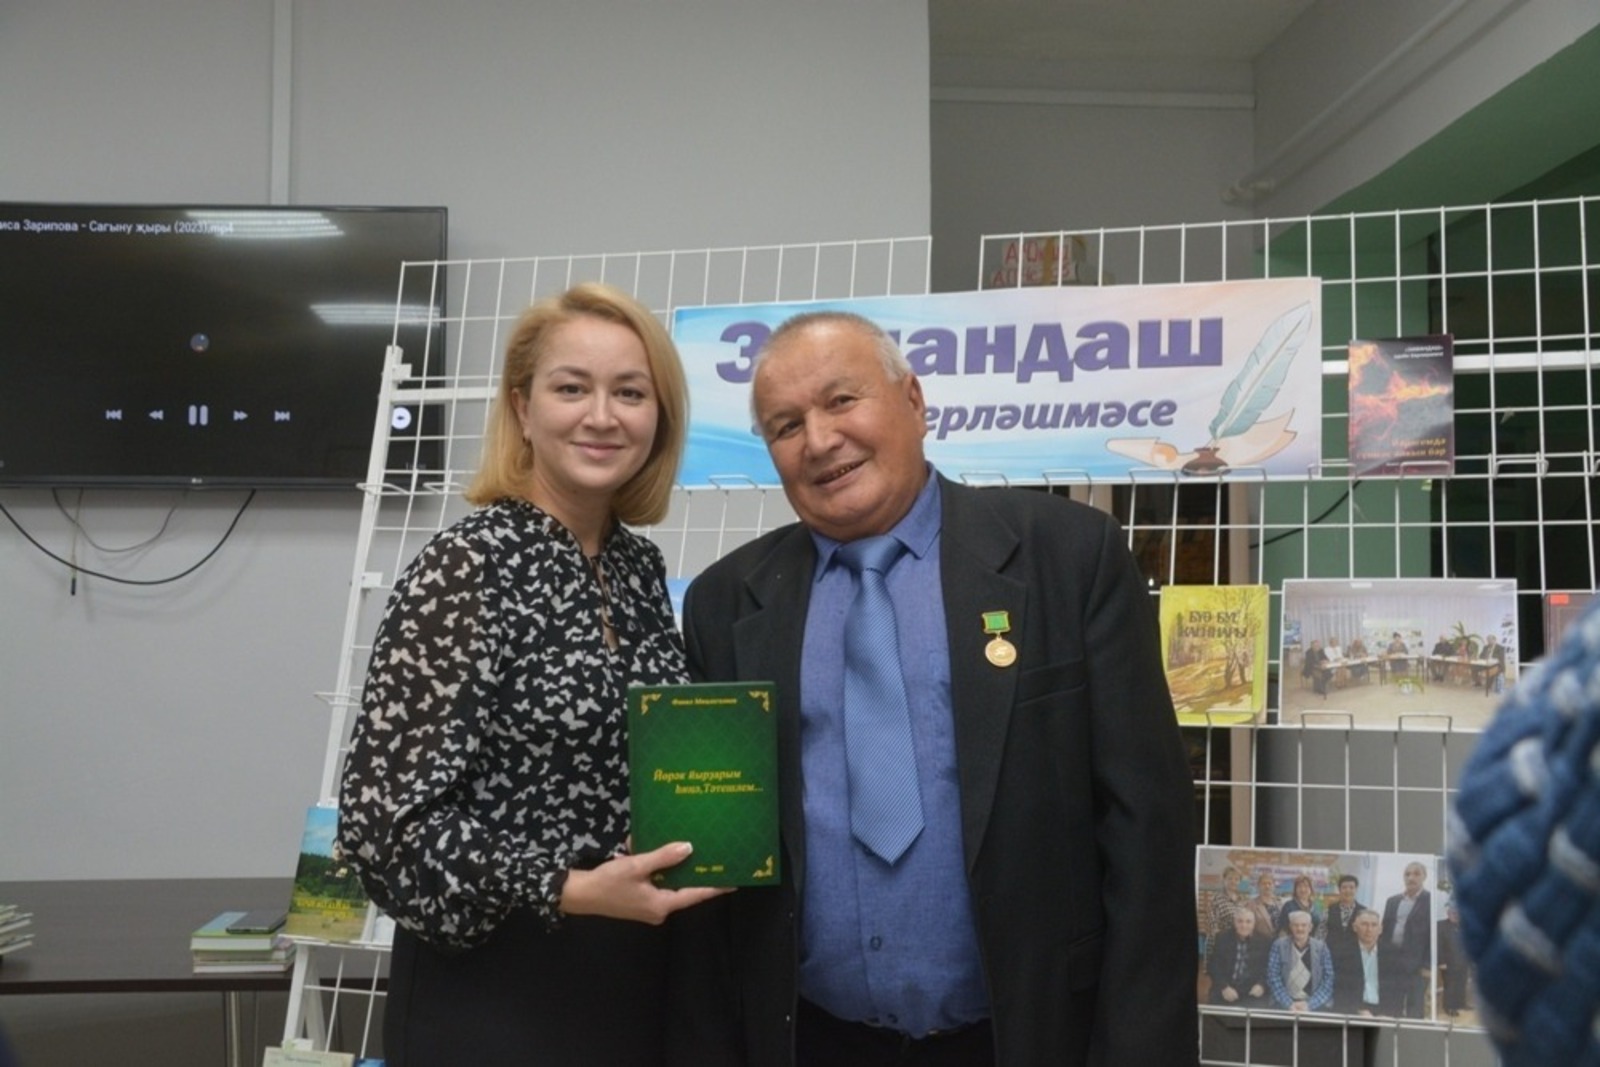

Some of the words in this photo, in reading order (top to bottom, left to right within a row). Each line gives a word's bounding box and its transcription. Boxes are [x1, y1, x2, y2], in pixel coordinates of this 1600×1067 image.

[23, 218, 79, 233] Зарипова
[89, 220, 132, 234] Сагыну
[135, 223, 171, 235] җыры
[716, 317, 1223, 384] Зандаш
[922, 399, 1178, 440] ерләшмәсе
